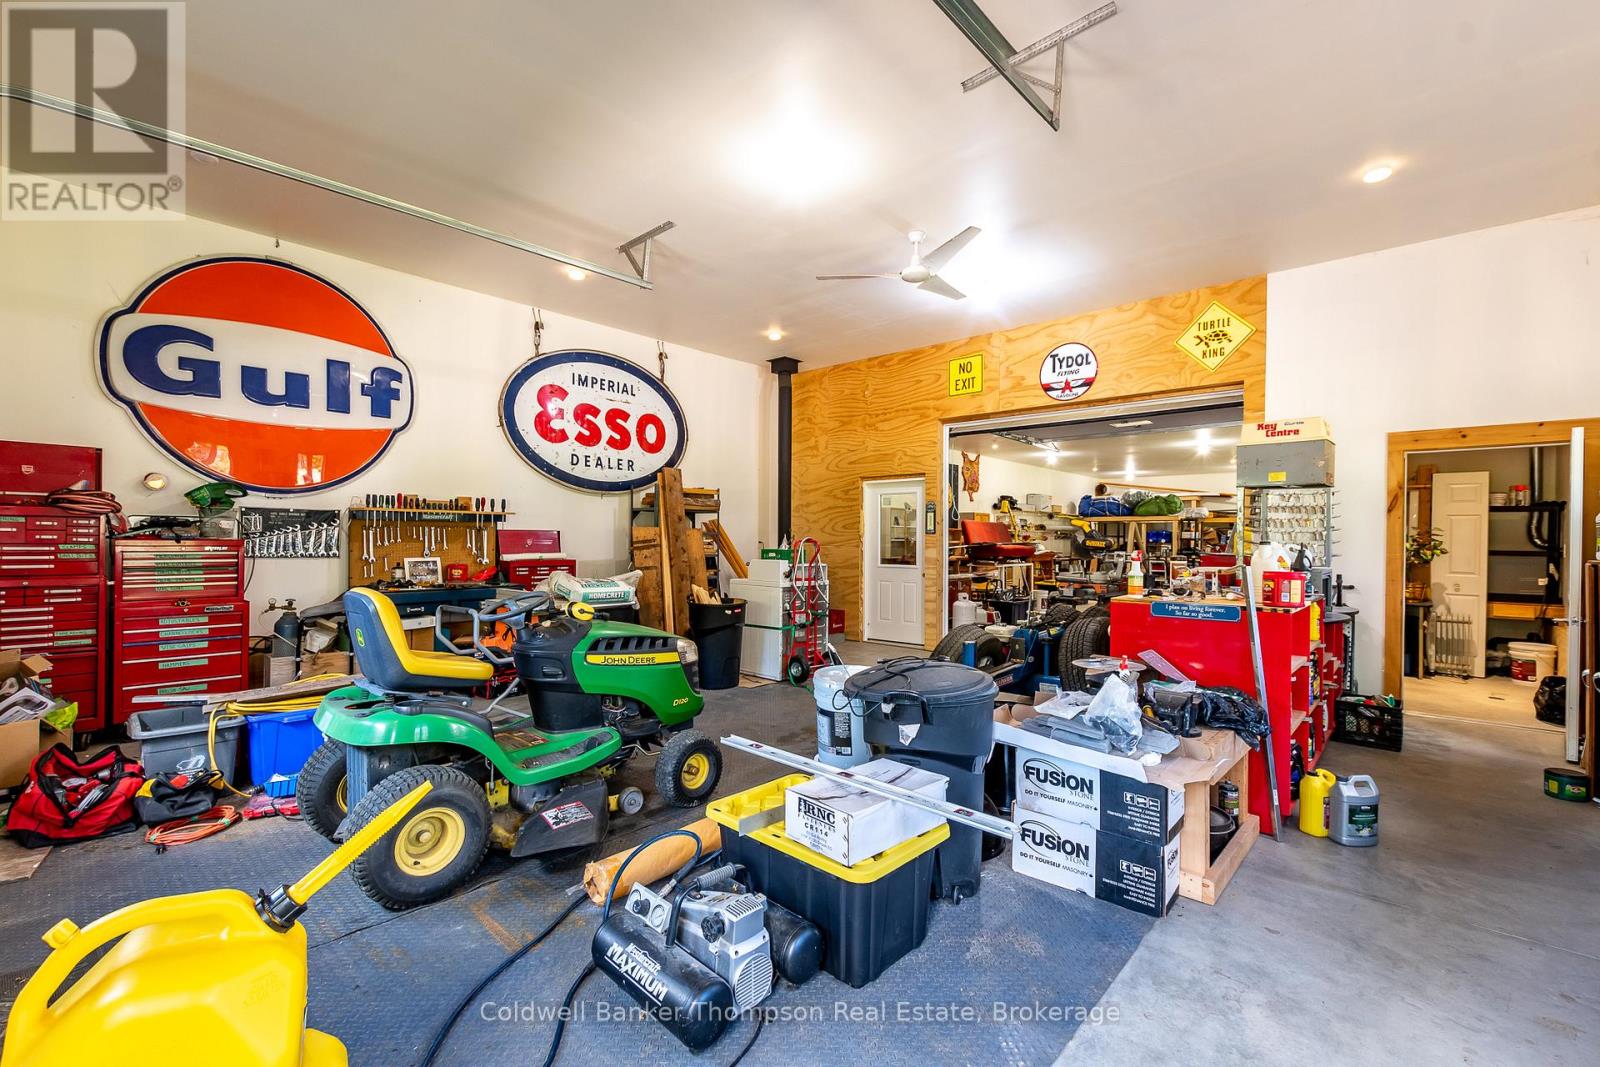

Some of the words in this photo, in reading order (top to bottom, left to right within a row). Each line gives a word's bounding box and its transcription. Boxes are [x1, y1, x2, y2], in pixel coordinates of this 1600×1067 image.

[1198, 317, 1230, 332] TURTLE
[1202, 347, 1225, 359] KING
[958, 361, 973, 375] NO
[1050, 352, 1092, 374] TYDOL
[122, 324, 402, 418] Gulf
[1056, 368, 1080, 377] FLYING
[572, 372, 636, 396] IMPERIAL
[954, 377, 976, 391] EXIT
[1266, 428, 1300, 437] Centre
[570, 454, 635, 472] DEALER
[601, 656, 626, 664] JOHN
[1040, 793, 1065, 803] YOURSELF
[1067, 800, 1093, 810] MASONRY
[1070, 790, 1094, 800] STONE
[1035, 856, 1061, 868] YOURSELF
[1062, 864, 1088, 876] MASONRY
[1065, 856, 1089, 867] STONE
[606, 942, 668, 1002] MAXIMUM
